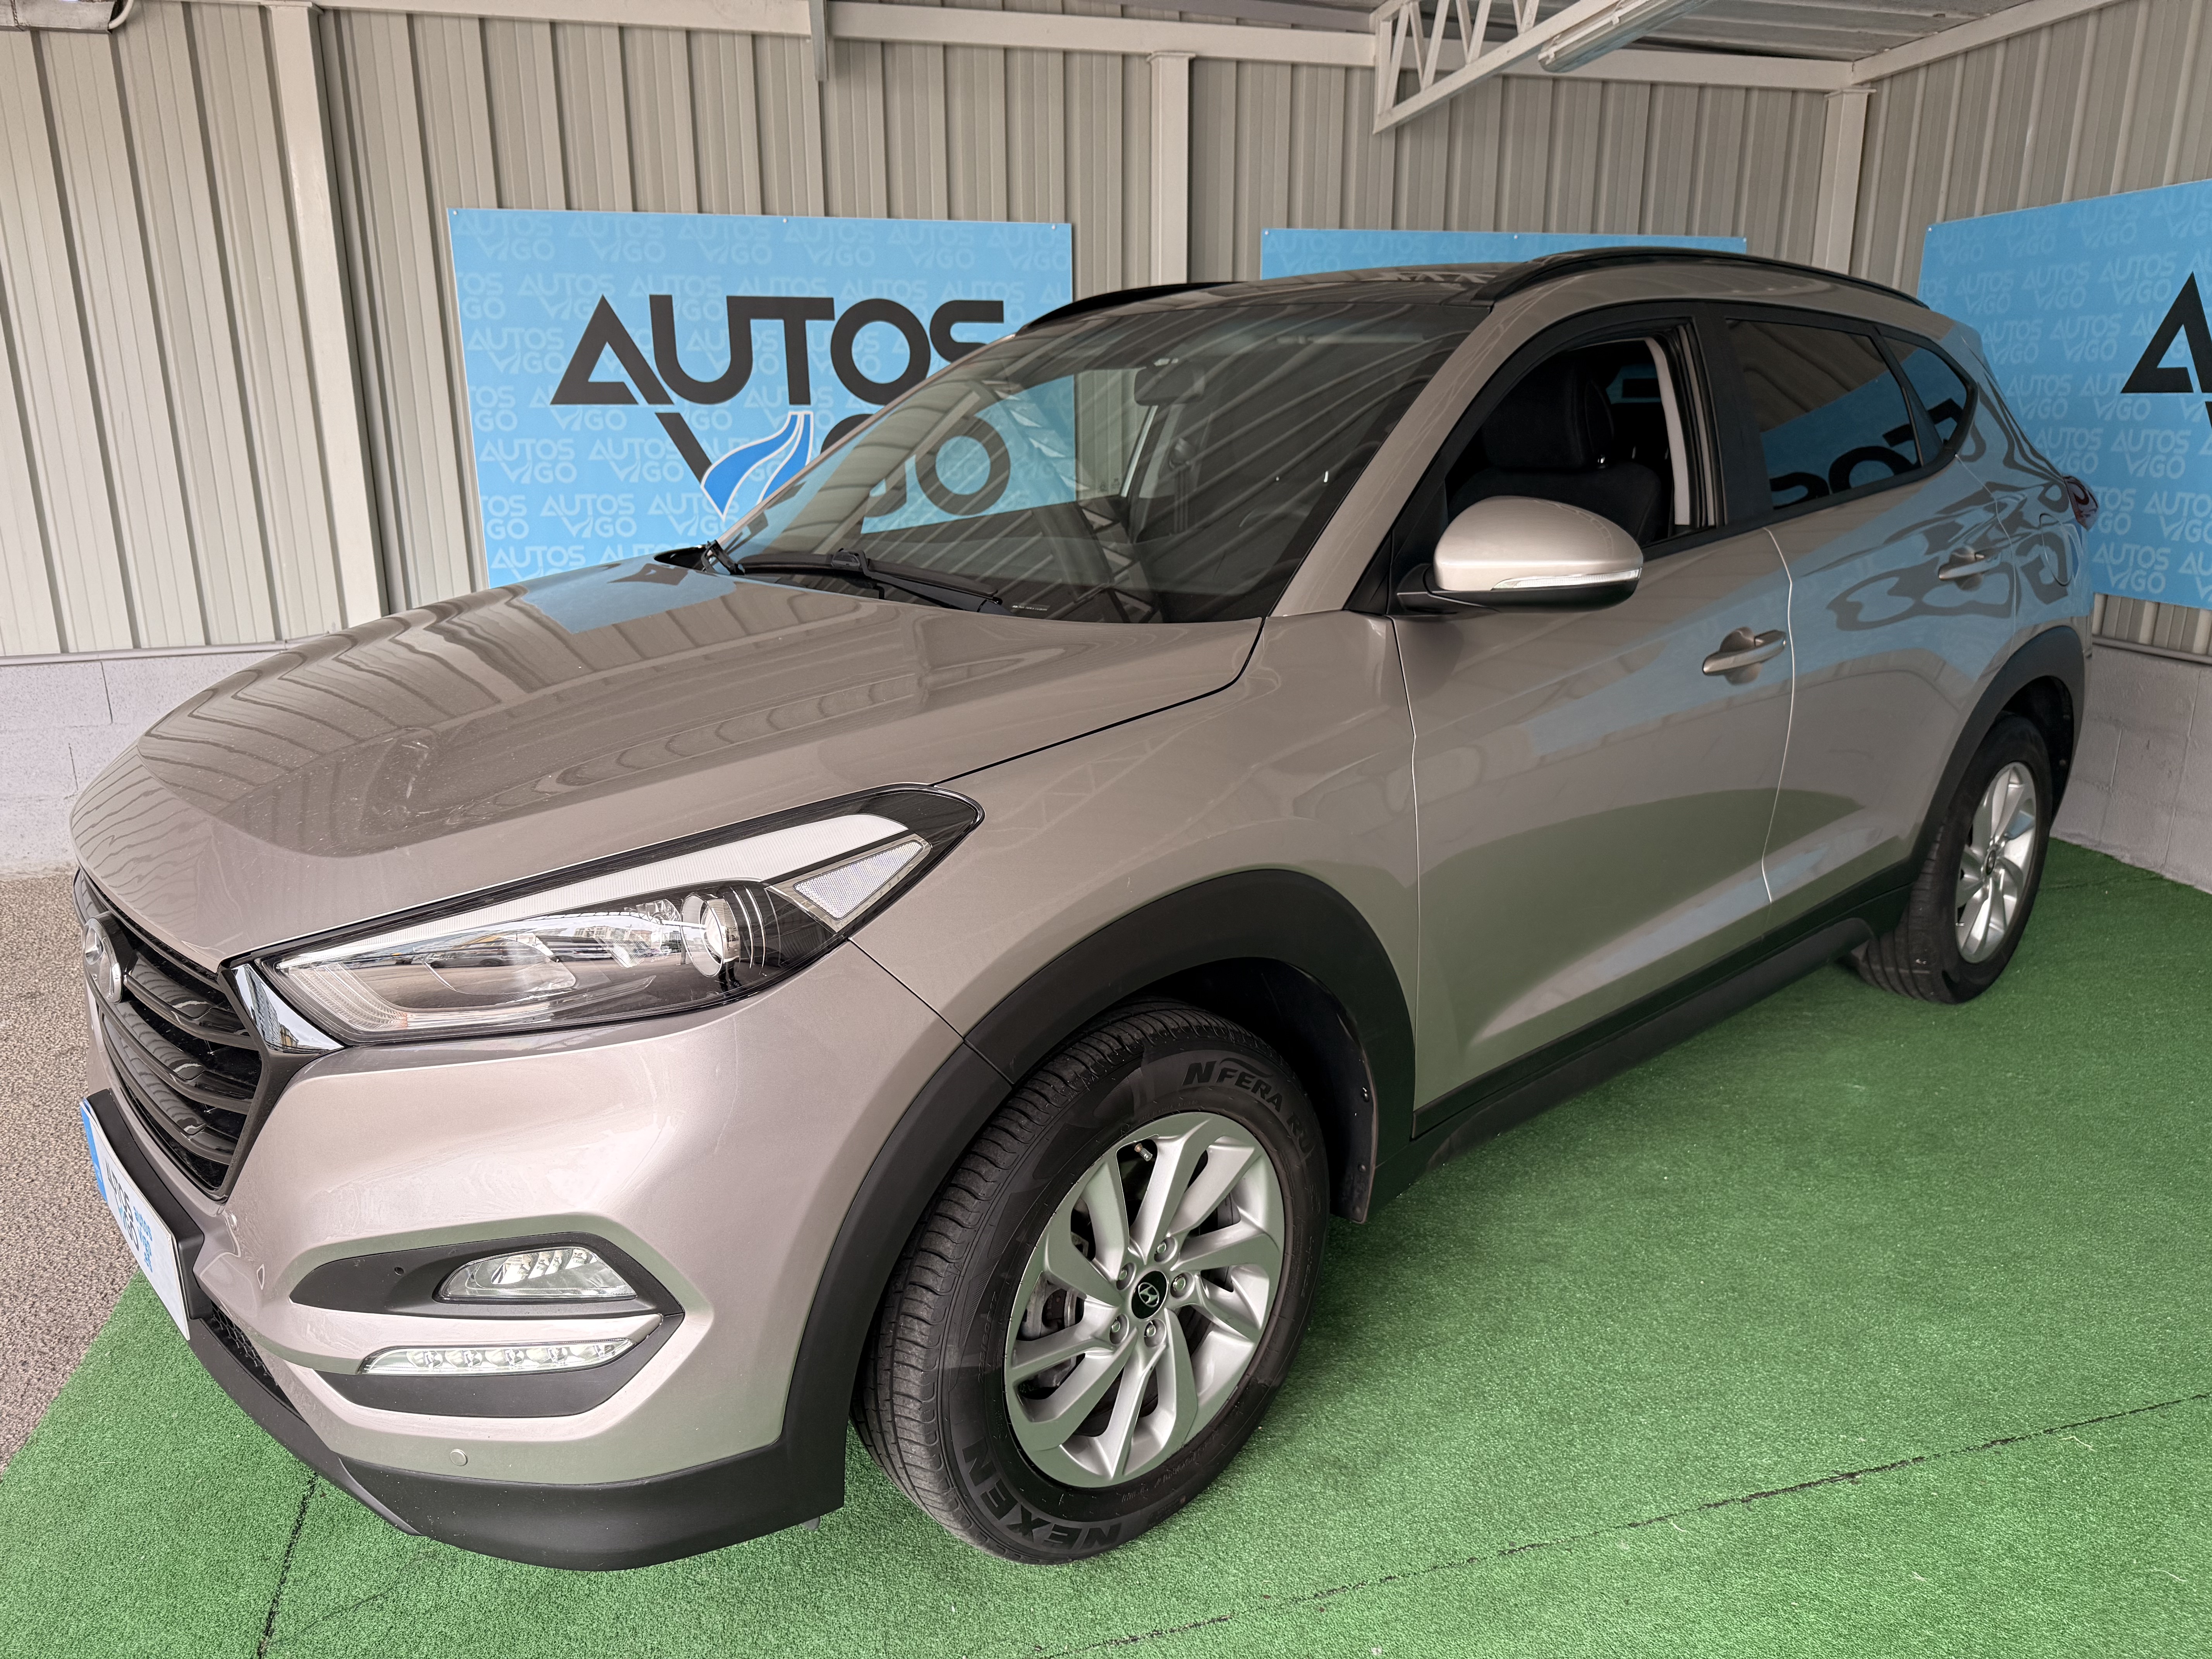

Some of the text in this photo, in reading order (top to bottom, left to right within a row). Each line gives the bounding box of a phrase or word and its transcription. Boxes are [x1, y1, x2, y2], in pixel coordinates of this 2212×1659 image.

[455, 213, 553, 236] AUTOS
[568, 214, 664, 238] AUTOS
[517, 272, 617, 297] AUTOS
[467, 328, 565, 350] AUTOS
[487, 350, 567, 374] VIGO
[479, 438, 576, 461] AUTOS
[2033, 426, 2104, 452] AUTOS
[2111, 428, 2192, 456] AUTOS
[500, 460, 577, 484] VIGO
[608, 460, 685, 483] VIGO
[2124, 453, 2186, 480] VIGO
[539, 493, 635, 517] AUTOS
[560, 516, 638, 539] VIGO
[2097, 511, 2132, 536] GO
[490, 545, 586, 570] AUTOS
[2092, 541, 2172, 572] AUTOS
[2106, 563, 2166, 594] VIGO
[962, 1436, 1123, 1549] NEXEN
